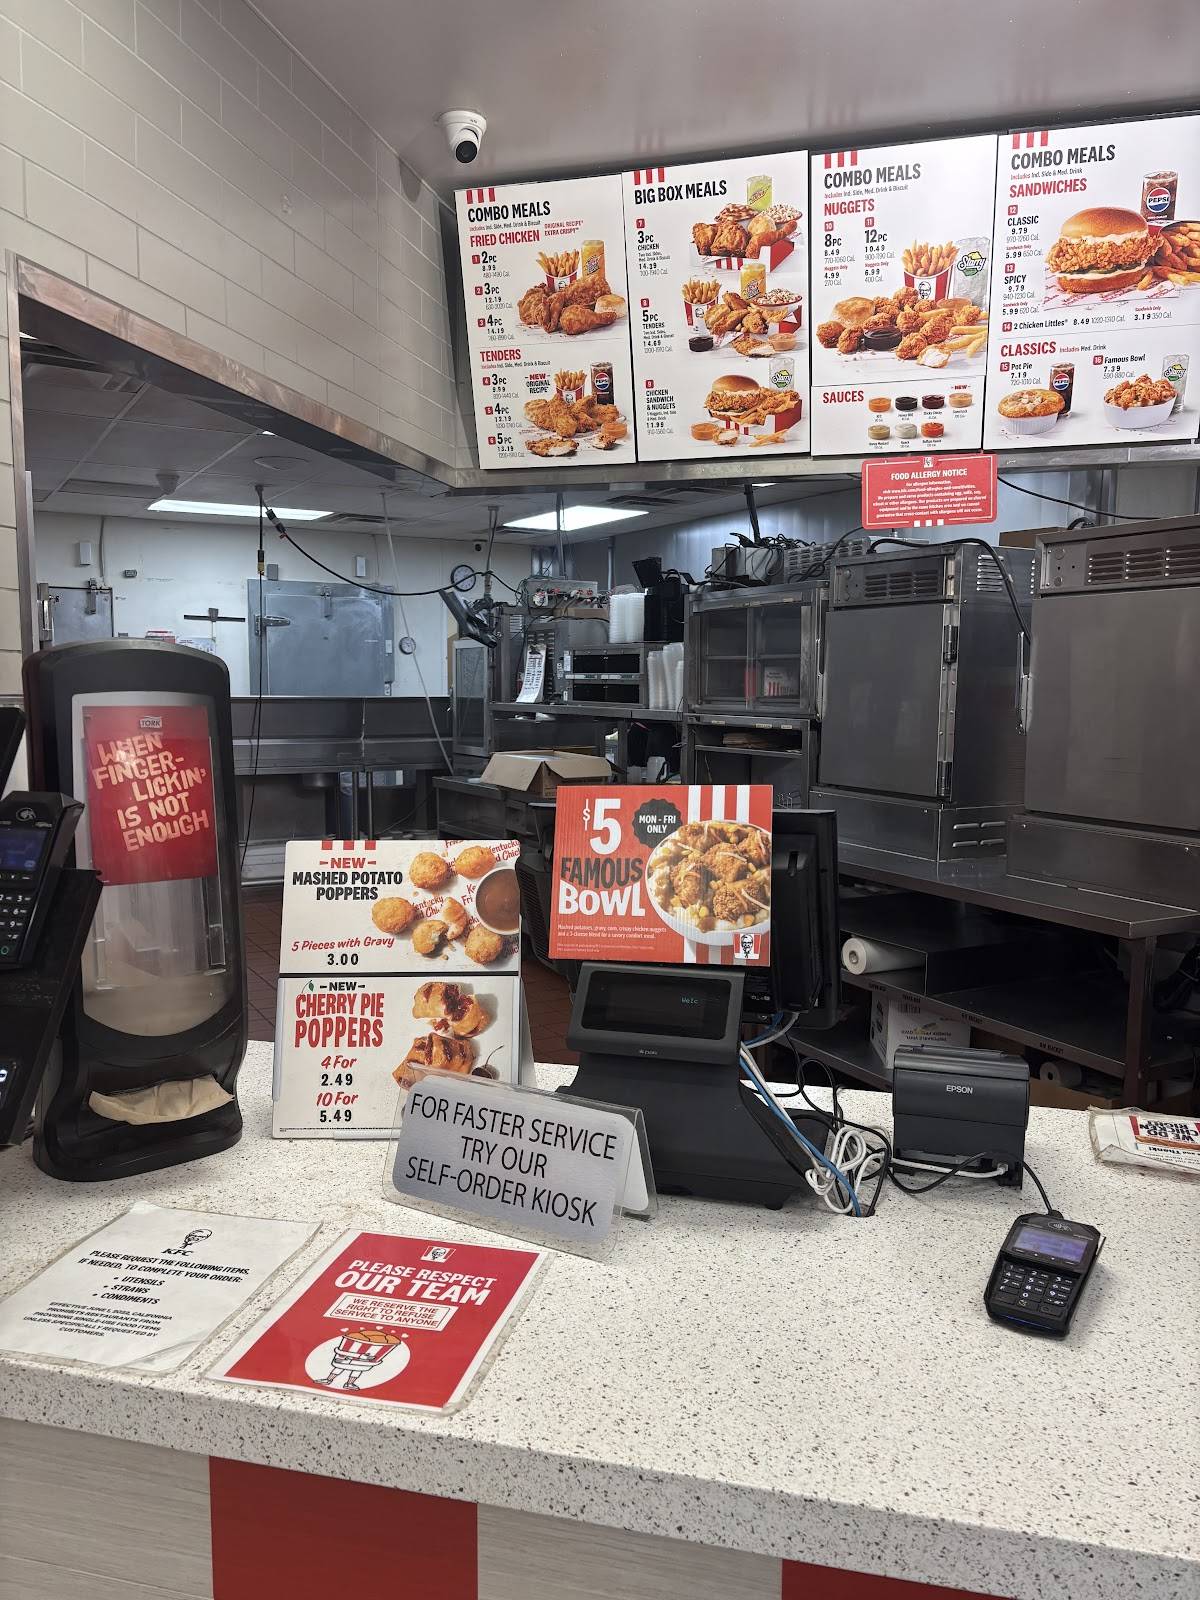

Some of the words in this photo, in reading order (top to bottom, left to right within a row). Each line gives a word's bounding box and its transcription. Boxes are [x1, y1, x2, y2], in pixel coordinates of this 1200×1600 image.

[1011, 150, 1063, 170] COMBO
[1067, 145, 1116, 165] MEALS
[824, 169, 872, 189] COMBO
[876, 163, 921, 184] MEALS
[634, 188, 655, 205] BIG
[658, 185, 684, 202] BOX
[685, 180, 727, 199] MEALS
[1009, 178, 1087, 198] SANDWICHES
[468, 205, 509, 222] COMBO
[512, 200, 551, 219] MEALS
[824, 199, 875, 216] NUGGETS
[1007, 216, 1039, 226] CLASSIC
[638, 231, 654, 243] 3PC
[865, 229, 887, 243] 12PC
[1011, 227, 1028, 235] 9.79
[470, 233, 496, 247] FRIED
[499, 230, 540, 244] CHICKEN
[825, 234, 842, 247] 8PC
[481, 251, 497, 264] 2PC
[1006, 251, 1022, 259] 5.99
[1004, 275, 1027, 284] SPICY
[484, 283, 500, 295] 3PC
[1008, 284, 1025, 292] 9.79
[642, 310, 659, 322] 5PC
[1002, 307, 1019, 315] 5.99
[487, 314, 503, 326] 4PC
[1019, 321, 1044, 330] Chicken
[480, 349, 522, 362] TENDERS
[1000, 341, 1057, 357] CLASSICS
[1023, 362, 1033, 370] Pie
[1104, 356, 1129, 364] Famous
[1130, 354, 1146, 362] Bowl
[1103, 365, 1121, 373] 7.39
[492, 374, 507, 386] 3PC
[823, 391, 864, 404] SAUCES
[495, 403, 510, 415] 4PC
[497, 433, 512, 444] 5PC
[911, 471, 941, 479] ALLERGY
[943, 468, 968, 477] NOTICE
[141, 719, 161, 727] TORK
[96, 732, 164, 766] WHEN
[92, 751, 185, 790] FINGER-
[117, 805, 142, 830] IS
[148, 791, 190, 820] NOT
[582, 798, 622, 855] $5
[639, 815, 657, 824] MON
[663, 815, 676, 824] FRI
[122, 809, 210, 852] ENOUGH
[647, 824, 668, 834] ONLY
[293, 871, 348, 885] MASHED
[351, 871, 403, 885] POTATO
[561, 857, 644, 889] FAMOUS
[316, 887, 378, 900] POPPERS
[558, 879, 645, 917] BOWL
[292, 941, 300, 952] 5
[302, 938, 336, 951] Pieces
[337, 937, 361, 949] with
[363, 936, 395, 949] Gravy
[327, 953, 359, 965] 3.00
[296, 993, 356, 1018] CHERRY
[361, 993, 385, 1018] PIE
[294, 1017, 383, 1048] POPPERS
[321, 1055, 331, 1069] 4
[334, 1055, 358, 1069] For
[321, 1073, 353, 1087] 2.49
[946, 1084, 974, 1095] EPSON
[316, 1092, 333, 1107] 10
[335, 1092, 358, 1106] For
[320, 1109, 352, 1123] 5.49
[411, 1093, 449, 1122] FOR
[453, 1102, 525, 1139] FASTER
[529, 1118, 617, 1161] SERVICE
[1140, 1124, 1199, 1136] CHICKEN
[1173, 1133, 1195, 1142] WE
[461, 1135, 497, 1166] TRY
[501, 1146, 548, 1179] OUR
[405, 1156, 527, 1208] SELF-ORDER
[531, 1187, 598, 1227] KIOSK
[161, 1248, 194, 1257] KFC
[89, 1250, 122, 1260] PLEASE
[120, 1253, 160, 1264] REQUEST
[158, 1258, 178, 1266] THE
[175, 1260, 224, 1273] FOLLOWING
[78, 1257, 89, 1265] IF
[137, 1265, 186, 1277] COMPLETE
[184, 1270, 212, 1279] YOUR
[209, 1274, 244, 1284] ORDER:
[349, 1259, 416, 1278] PLEASE
[415, 1268, 497, 1288] RESPECT
[121, 1276, 166, 1287] UTENSILS
[335, 1271, 402, 1295] OUR
[407, 1280, 491, 1306] TEAM
[111, 1284, 151, 1294] STRAWS
[100, 1292, 161, 1305] CONDIMENTS
[49, 1301, 88, 1310] EFFECTIVE
[131, 1311, 173, 1321] CALIFORNIA
[346, 1303, 380, 1313] RIGHT
[379, 1307, 394, 1315] TO
[395, 1309, 435, 1320] REFUSE
[369, 1300, 417, 1312] RESERVE
[419, 1306, 439, 1314] THE
[33, 1311, 73, 1320] PROVIDING
[116, 1321, 139, 1329] FOOD
[137, 1324, 161, 1332] ITEMS
[46, 1307, 86, 1316] PROHIBITS
[84, 1311, 139, 1322] RESTAURANTS
[137, 1317, 161, 1325] FROM
[335, 1309, 379, 1320] SERVICE
[394, 1316, 439, 1327] ANYONE
[50, 1319, 103, 1330] SPECIFICALLY
[102, 1326, 147, 1336] REQUESTED
